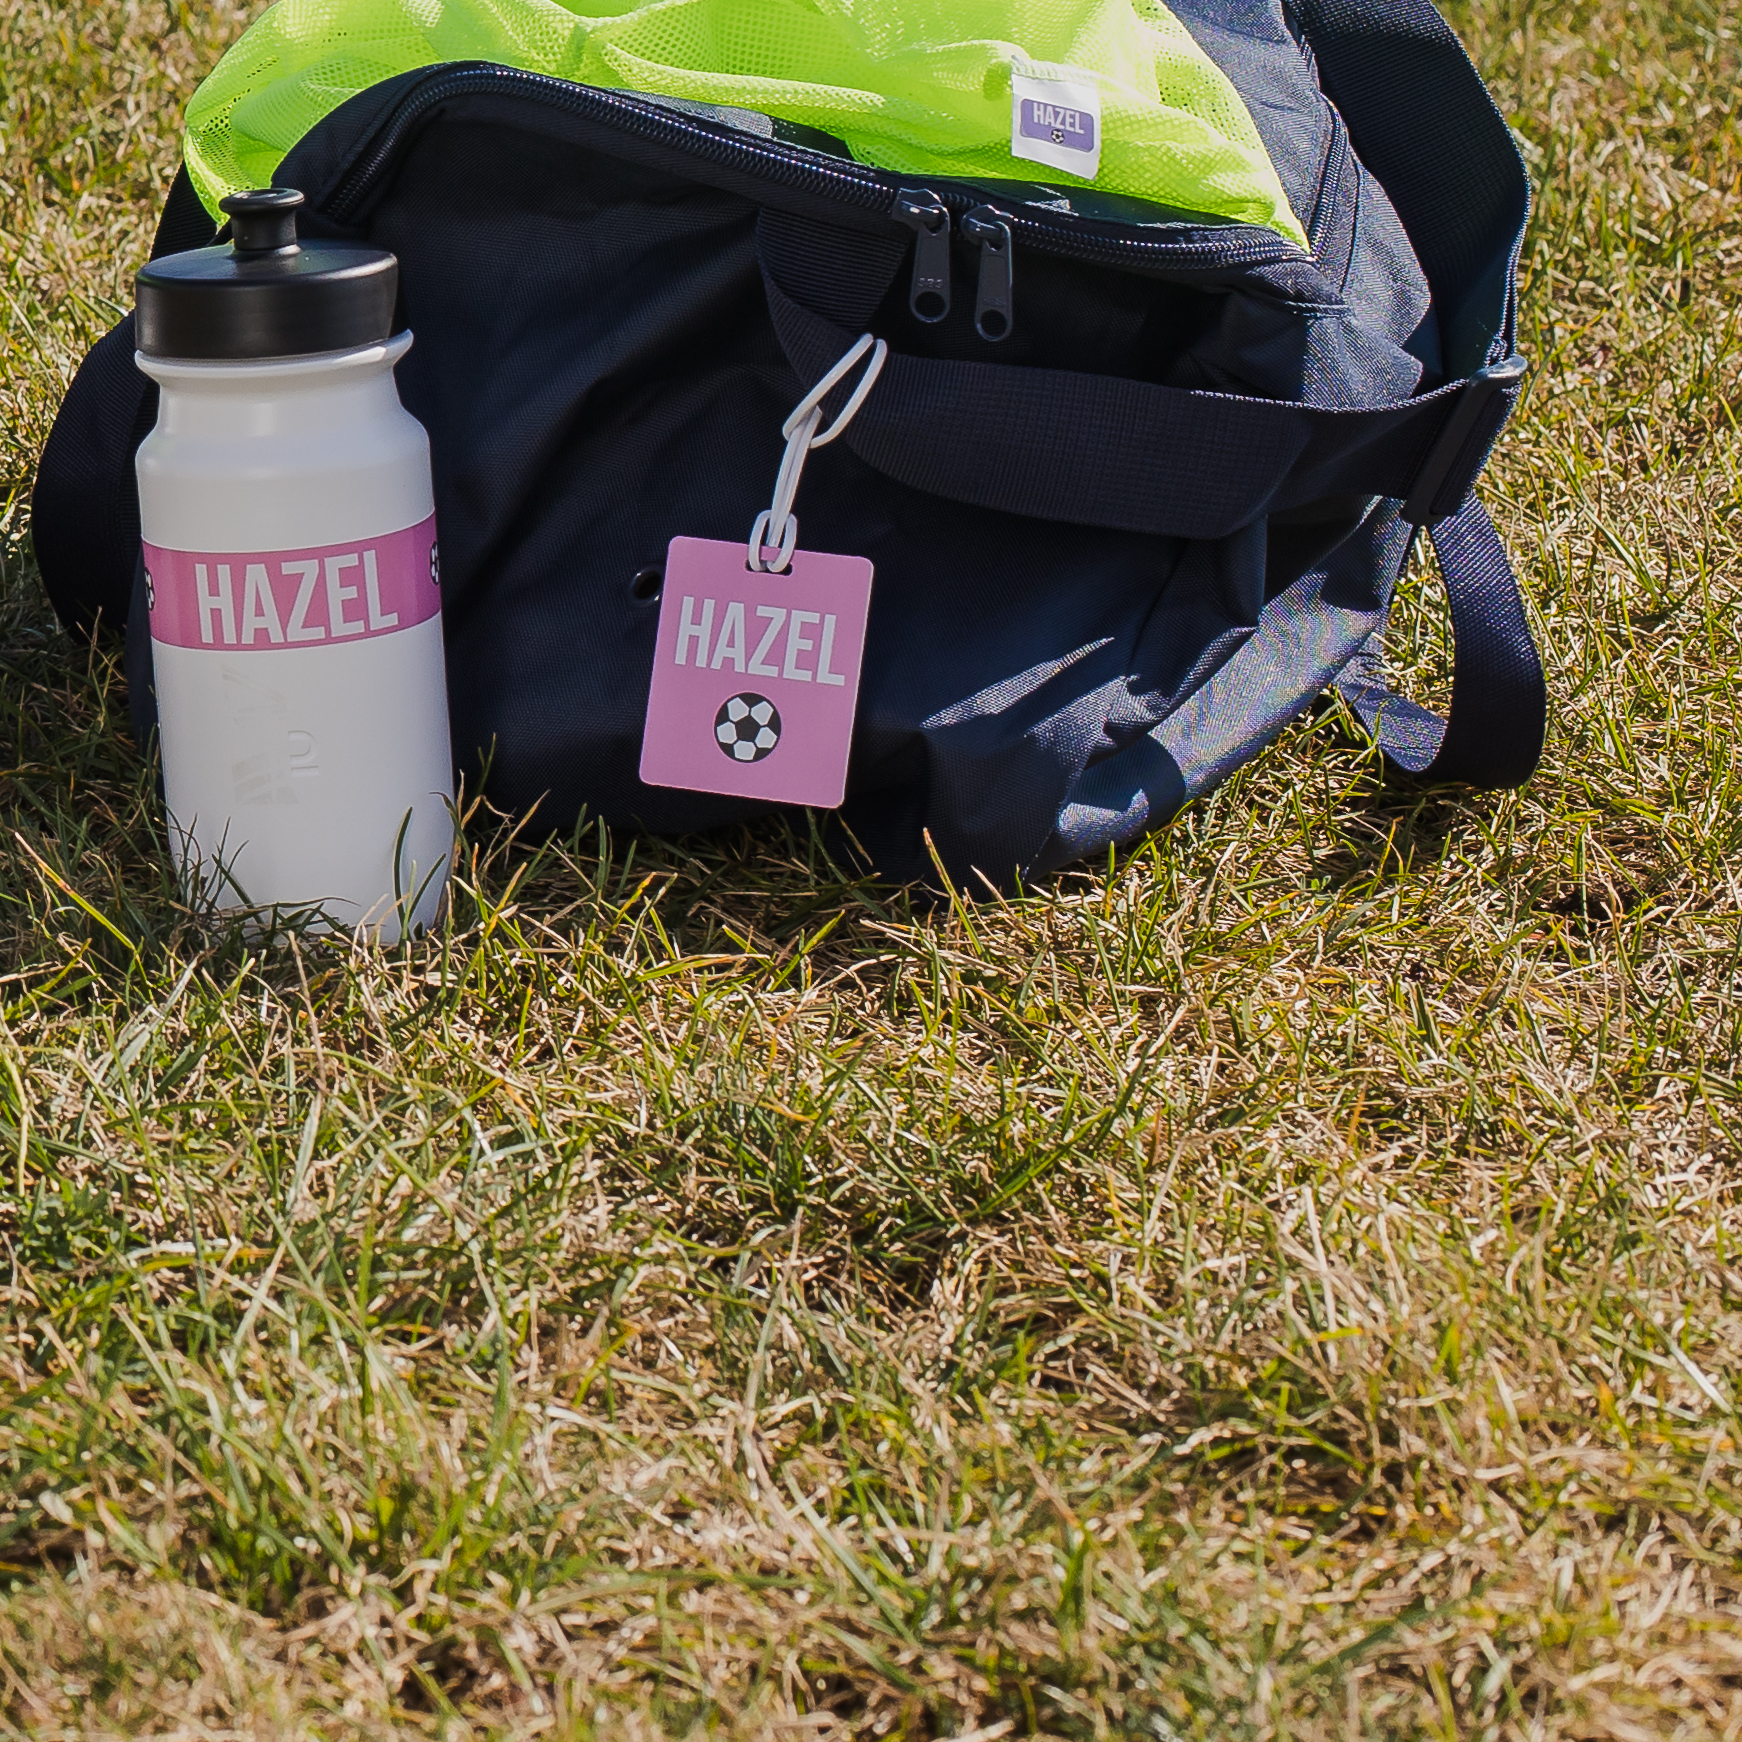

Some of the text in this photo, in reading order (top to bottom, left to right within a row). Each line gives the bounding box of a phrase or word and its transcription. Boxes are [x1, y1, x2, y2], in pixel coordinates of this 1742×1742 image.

[1032, 102, 1085, 134] HAZEL
[195, 549, 400, 645] HAZEL
[674, 595, 846, 687] HAZEL
